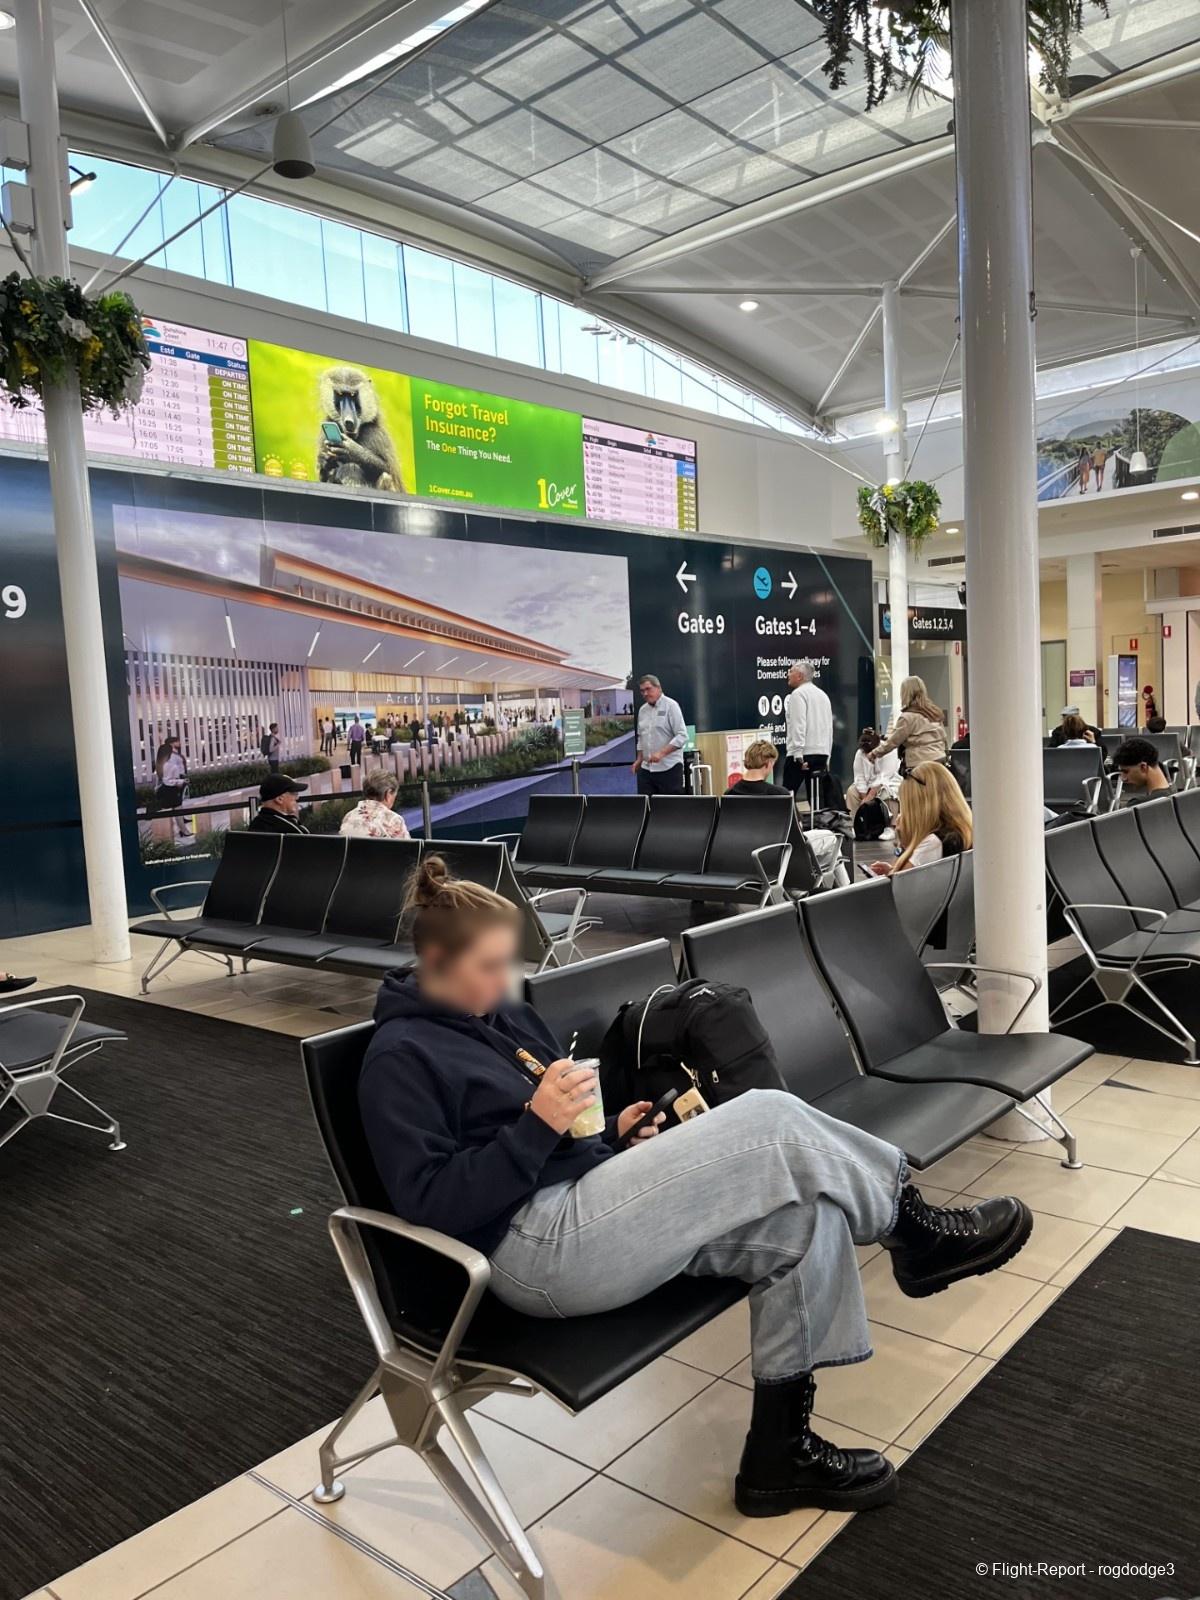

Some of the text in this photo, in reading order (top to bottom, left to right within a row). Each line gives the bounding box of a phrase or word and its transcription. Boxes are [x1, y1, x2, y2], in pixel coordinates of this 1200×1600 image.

[208, 339, 228, 350] 11:47
[160, 346, 246, 370] Estd Gate Status
[215, 368, 246, 380] DEPARTED
[424, 394, 508, 426] Forgot Travel
[426, 416, 496, 442] Insurance?
[426, 440, 512, 463] The One Thing You Need.
[428, 484, 473, 498] 1Cover.com.au
[2, 585, 26, 618] 9
[678, 612, 725, 634] Gate 9
[755, 616, 792, 636] Gates
[912, 617, 932, 629] Gates
[757, 656, 777, 666] Please
[822, 656, 830, 665] for
[757, 670, 787, 679] Domestic
[775, 722, 786, 732] and
